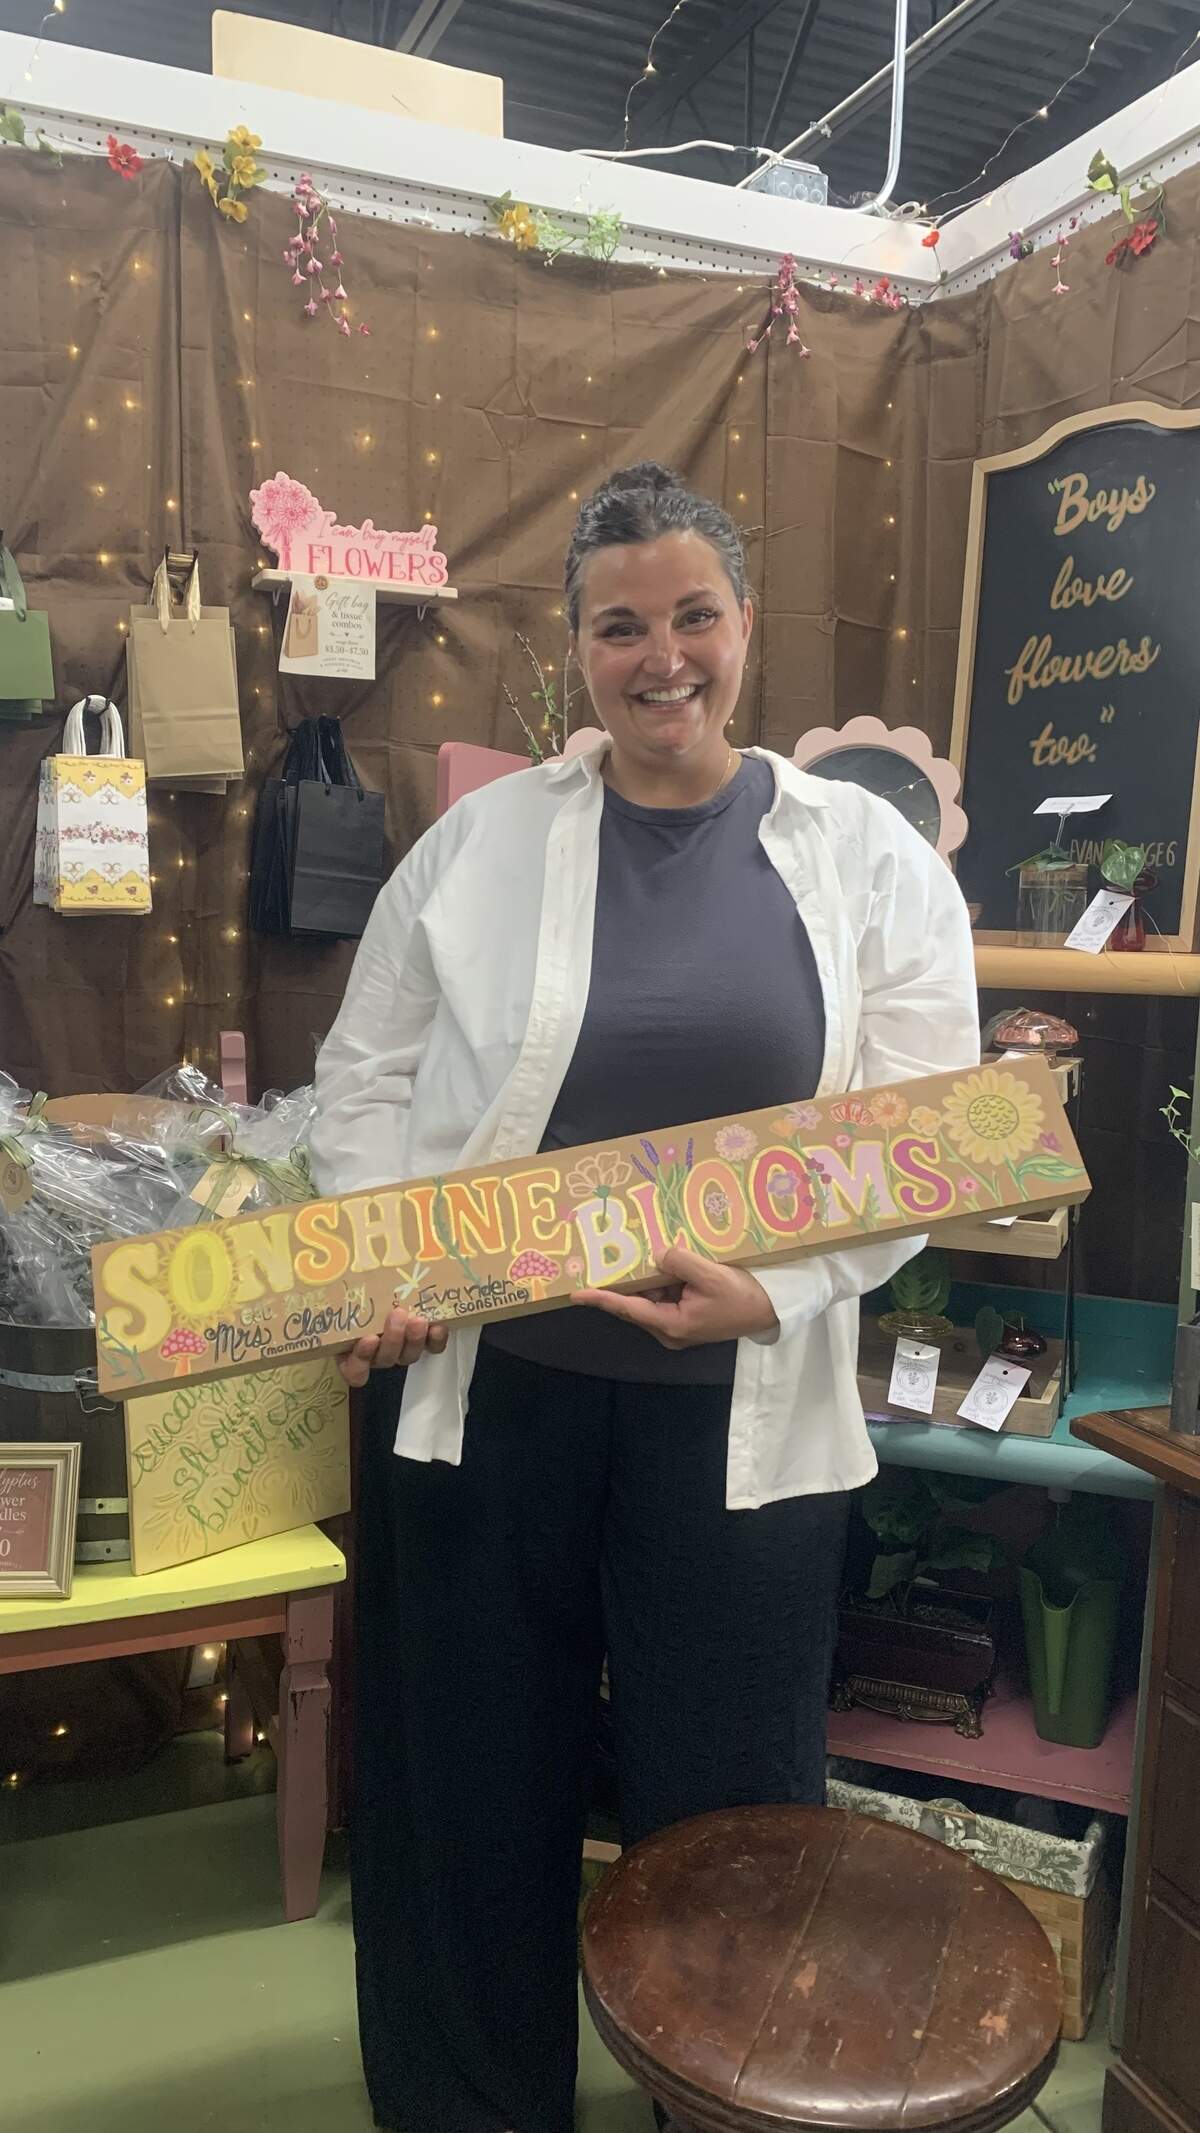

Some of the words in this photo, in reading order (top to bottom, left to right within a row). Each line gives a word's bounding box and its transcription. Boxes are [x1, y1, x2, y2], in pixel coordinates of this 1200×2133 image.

[391, 527, 435, 551] myself
[307, 543, 445, 585] FLOWERS
[1050, 555, 1135, 610] love
[324, 591, 351, 611] Gift
[351, 594, 370, 613] bag
[340, 610, 364, 620] tissue
[331, 620, 362, 630] combos
[1004, 633, 1161, 705] flowers
[101, 1166, 570, 1353] SONSHINE
[575, 1133, 957, 1289] BLOOMS
[453, 1287, 529, 1316] (sonshine)
[203, 1322, 272, 1364] Mrs
[284, 1297, 376, 1341] Clark
[414, 1274, 514, 1312] Evander
[261, 1335, 322, 1358] (mommy)
